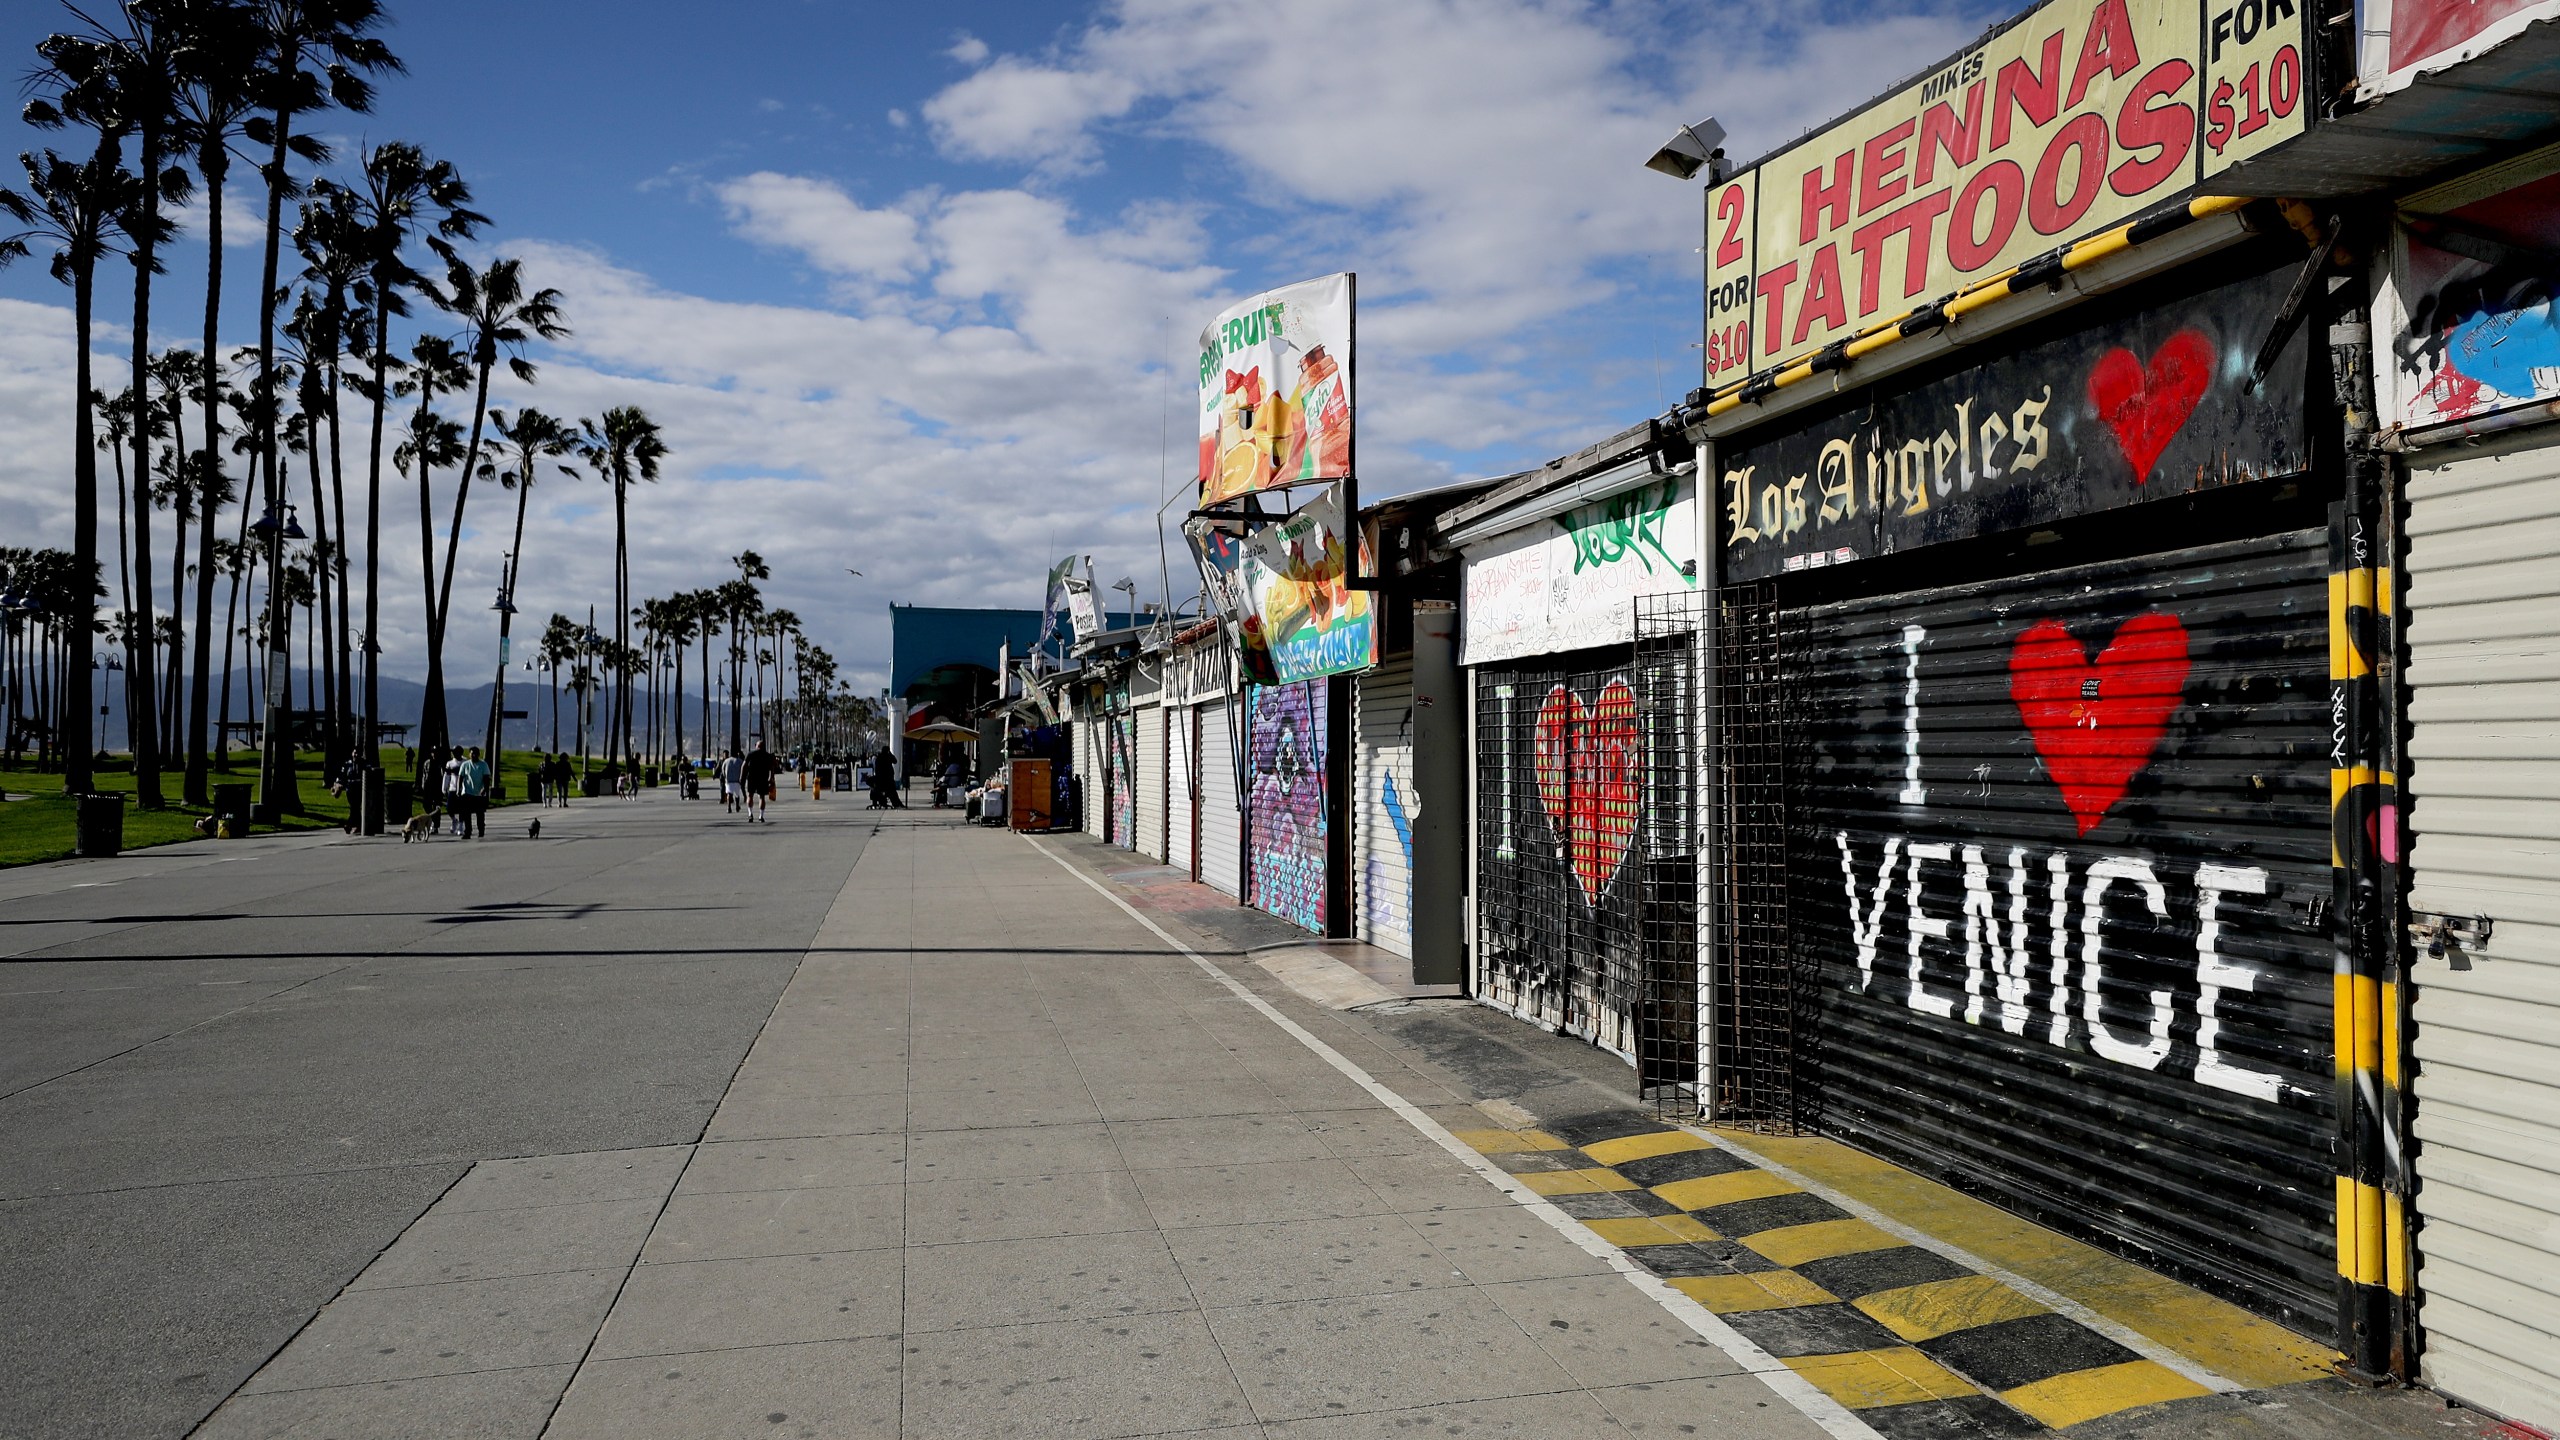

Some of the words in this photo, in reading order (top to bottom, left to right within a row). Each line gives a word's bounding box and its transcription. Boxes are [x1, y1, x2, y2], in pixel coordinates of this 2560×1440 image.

[1799, 0, 2140, 246] HENNA
[1920, 52, 1984, 106] MIKES
[2206, 44, 2300, 155] $10
[1716, 183, 1745, 269] 2
[1757, 58, 2194, 356] TATTOOS
[1708, 320, 1748, 378] $10
[1709, 275, 1749, 319] FOR
[1723, 464, 1808, 547] Los
[1816, 384, 2051, 530] Angeles
[1899, 624, 1927, 804] I
[1835, 831, 2283, 1104] VENICE
